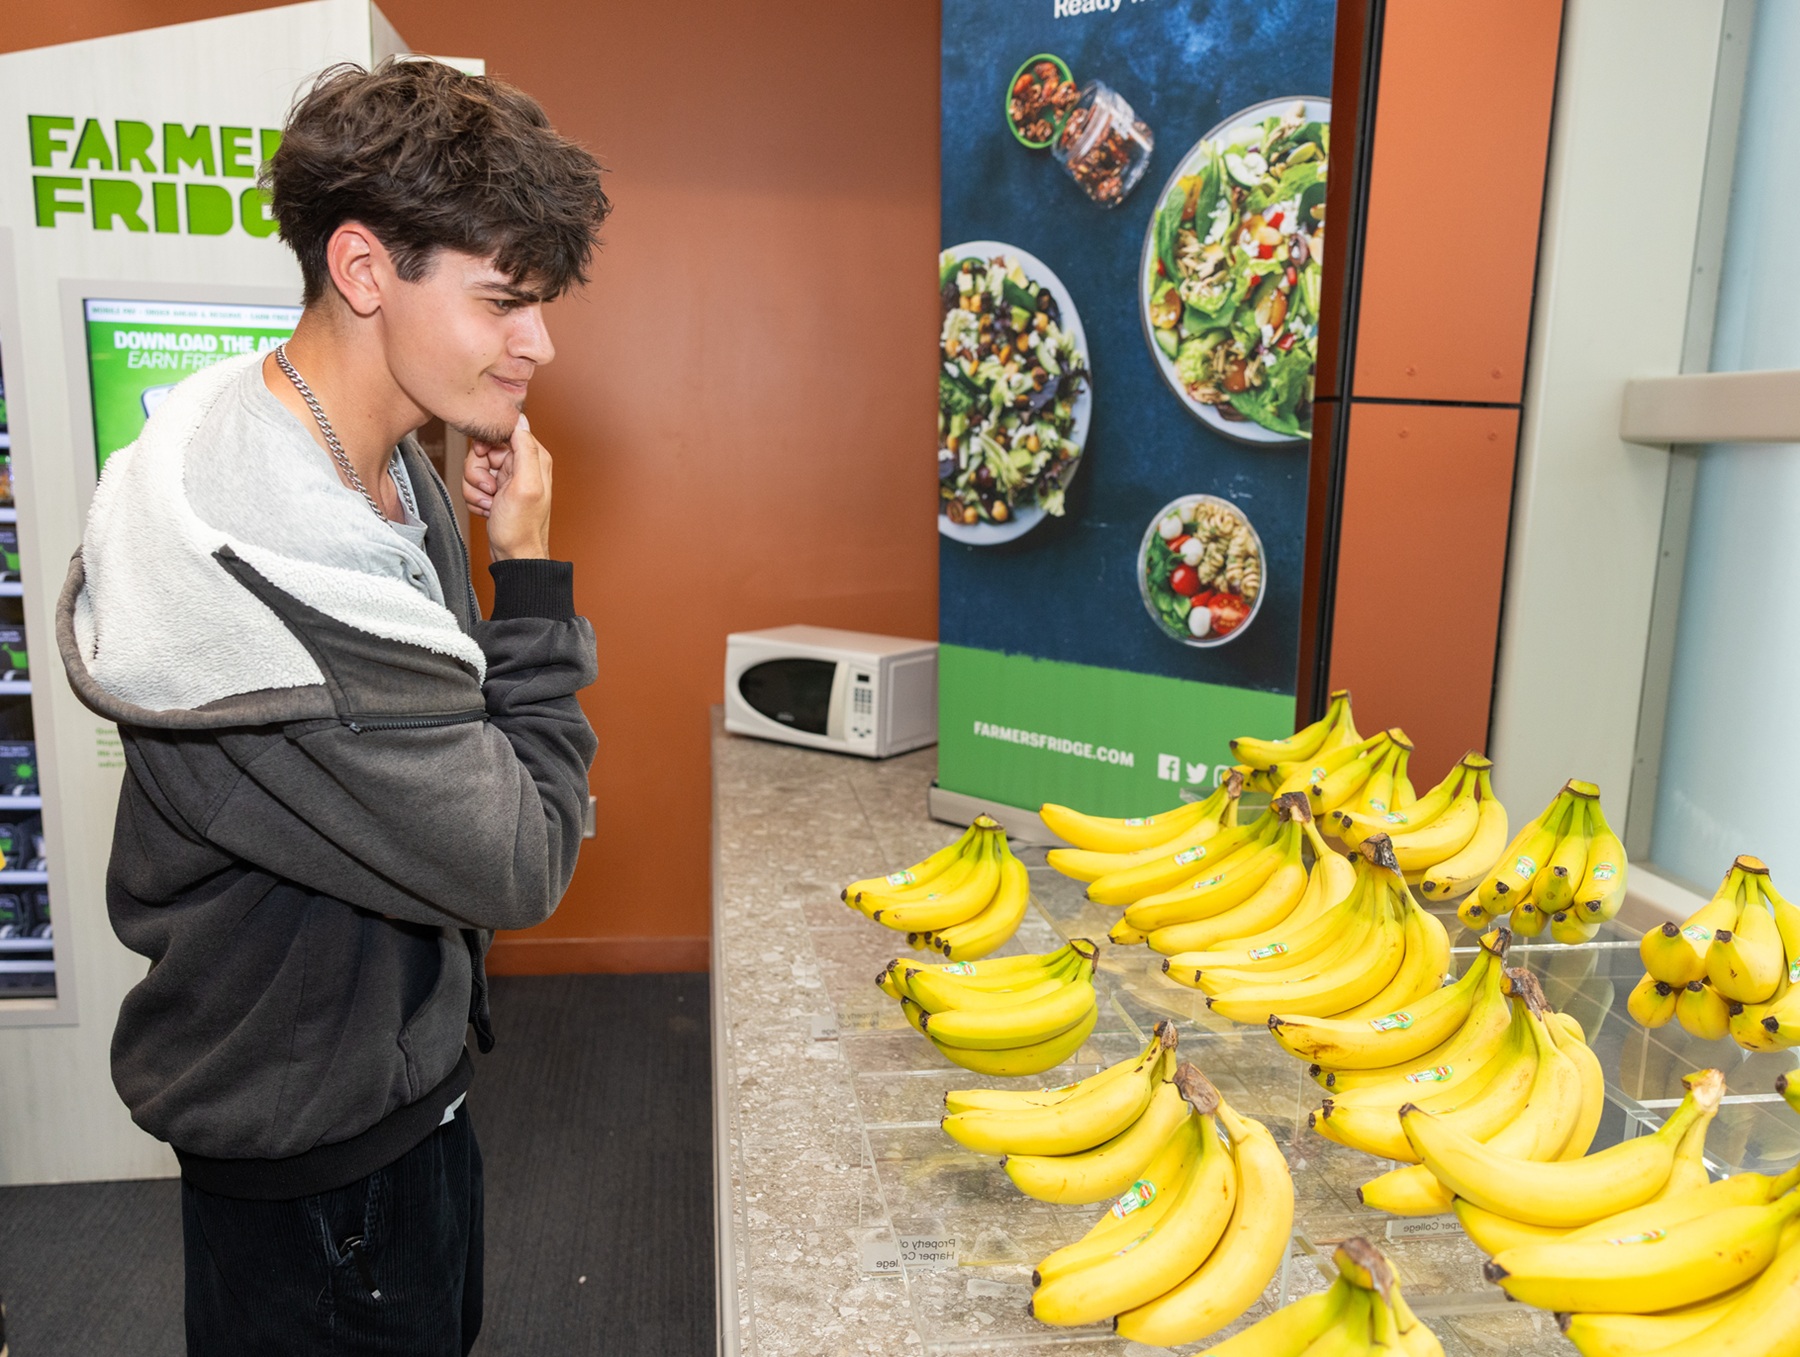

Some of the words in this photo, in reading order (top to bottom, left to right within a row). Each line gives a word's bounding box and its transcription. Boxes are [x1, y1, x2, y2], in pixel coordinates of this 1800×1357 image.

[32, 175, 281, 238] FRIDG
[114, 330, 218, 352] DOWNLOAD
[220, 335, 254, 353] THE
[127, 350, 179, 370] EARN
[974, 721, 1135, 767] FARMERSFRIDGE.COM
